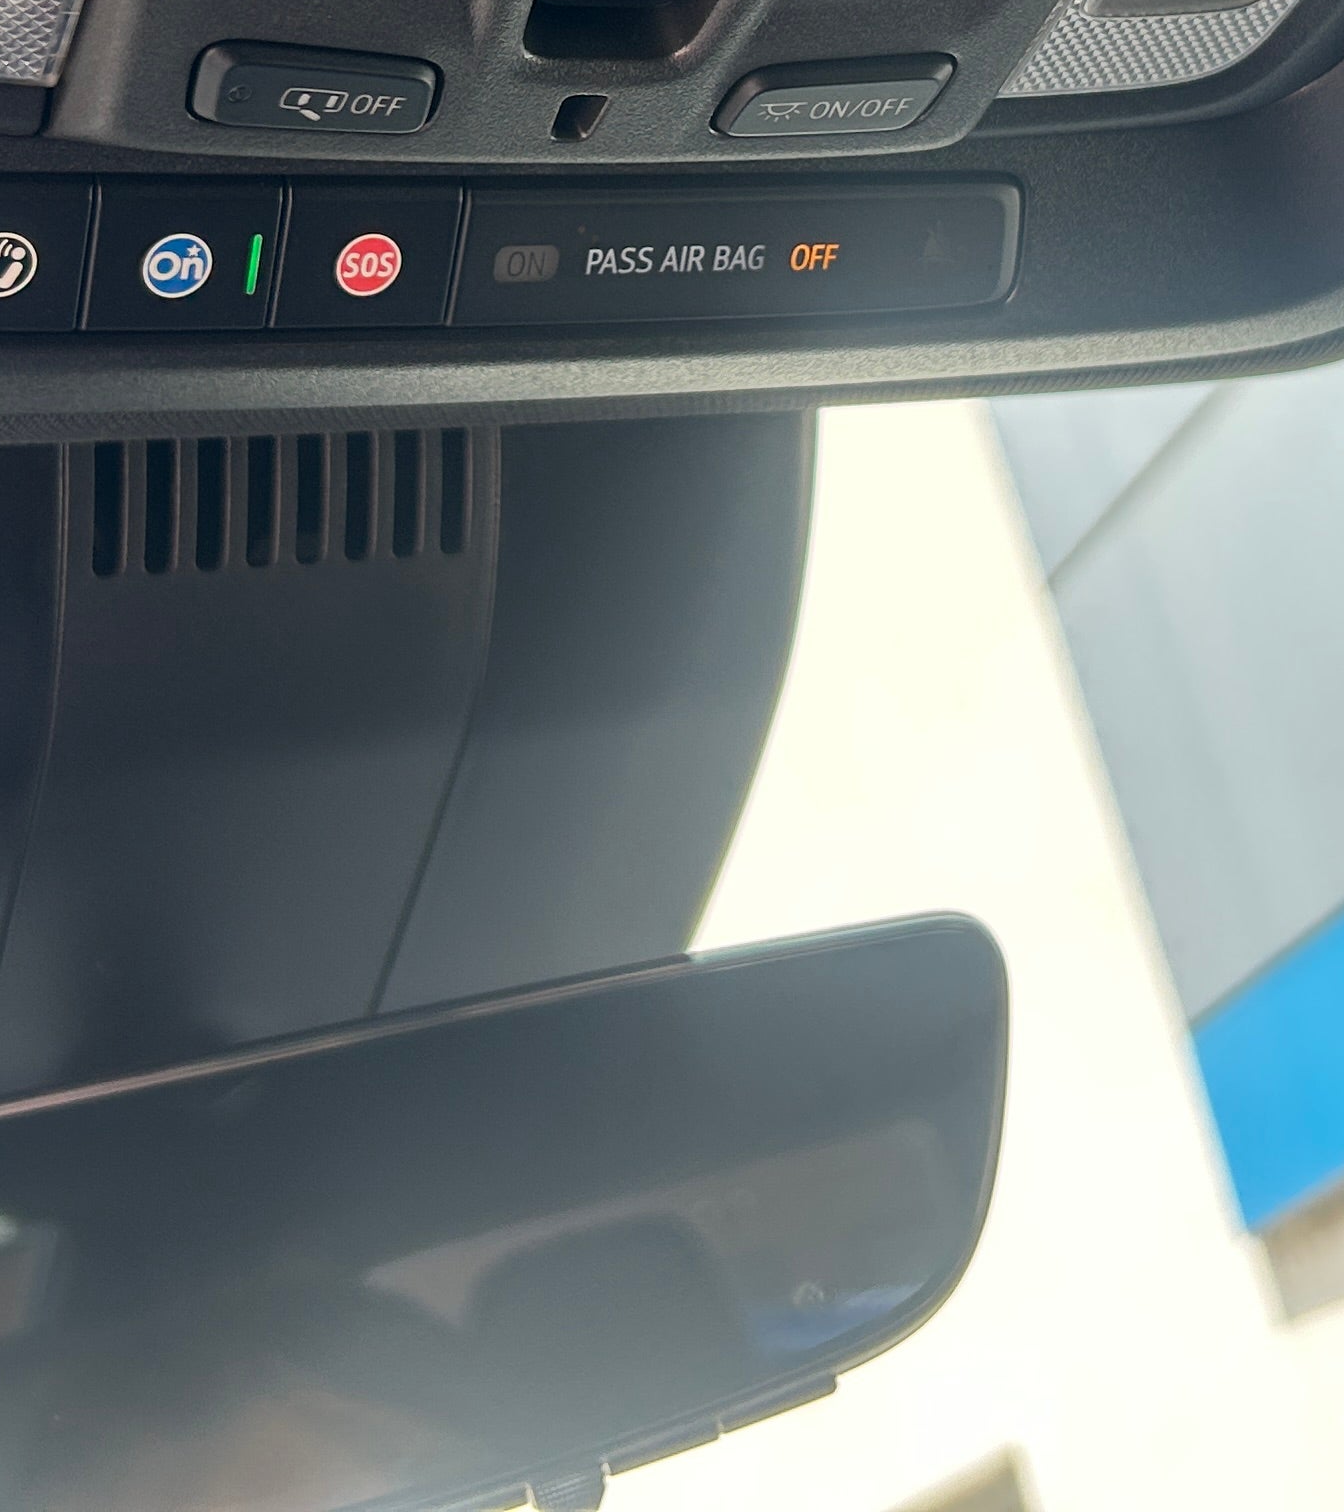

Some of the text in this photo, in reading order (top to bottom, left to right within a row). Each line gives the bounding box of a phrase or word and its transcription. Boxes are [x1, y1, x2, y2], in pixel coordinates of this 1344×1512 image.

[351, 94, 407, 117] OFF
[809, 97, 914, 120] ON/OFF
[149, 249, 204, 281] On
[343, 251, 394, 278] SOS
[507, 242, 840, 277] ON PASS AIR BAG OFF
